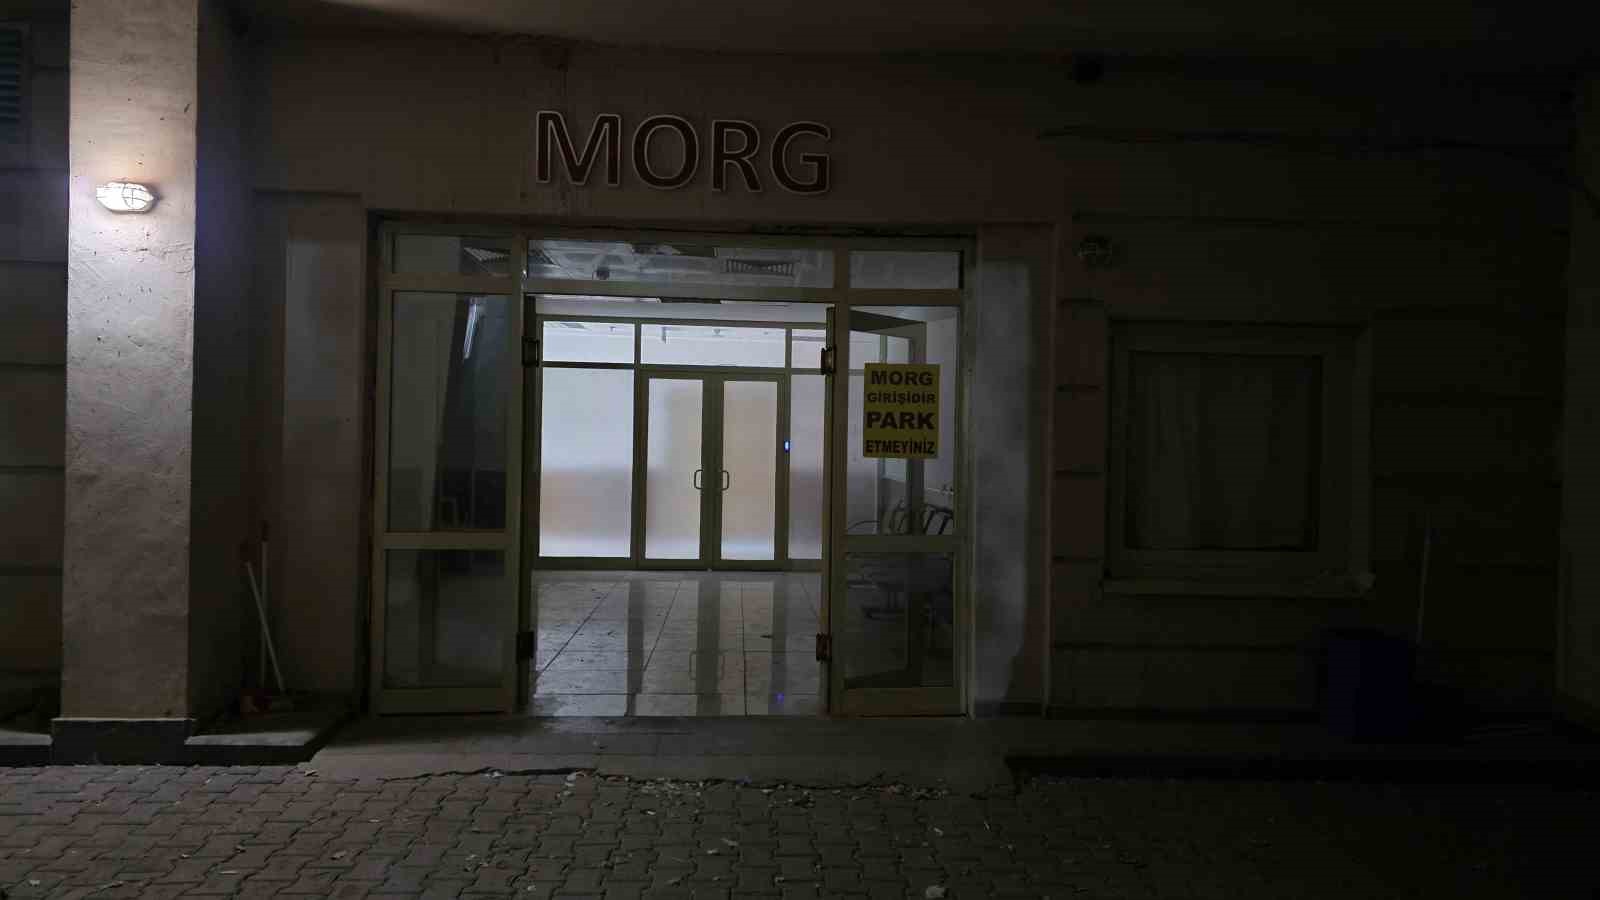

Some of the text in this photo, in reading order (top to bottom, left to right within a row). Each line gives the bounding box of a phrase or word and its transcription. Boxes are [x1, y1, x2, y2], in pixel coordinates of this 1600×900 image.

[536, 110, 832, 194] MORG
[871, 371, 933, 386] MORG
[867, 411, 935, 429] PARK
[866, 438, 935, 454] ETMEYİNİZ
